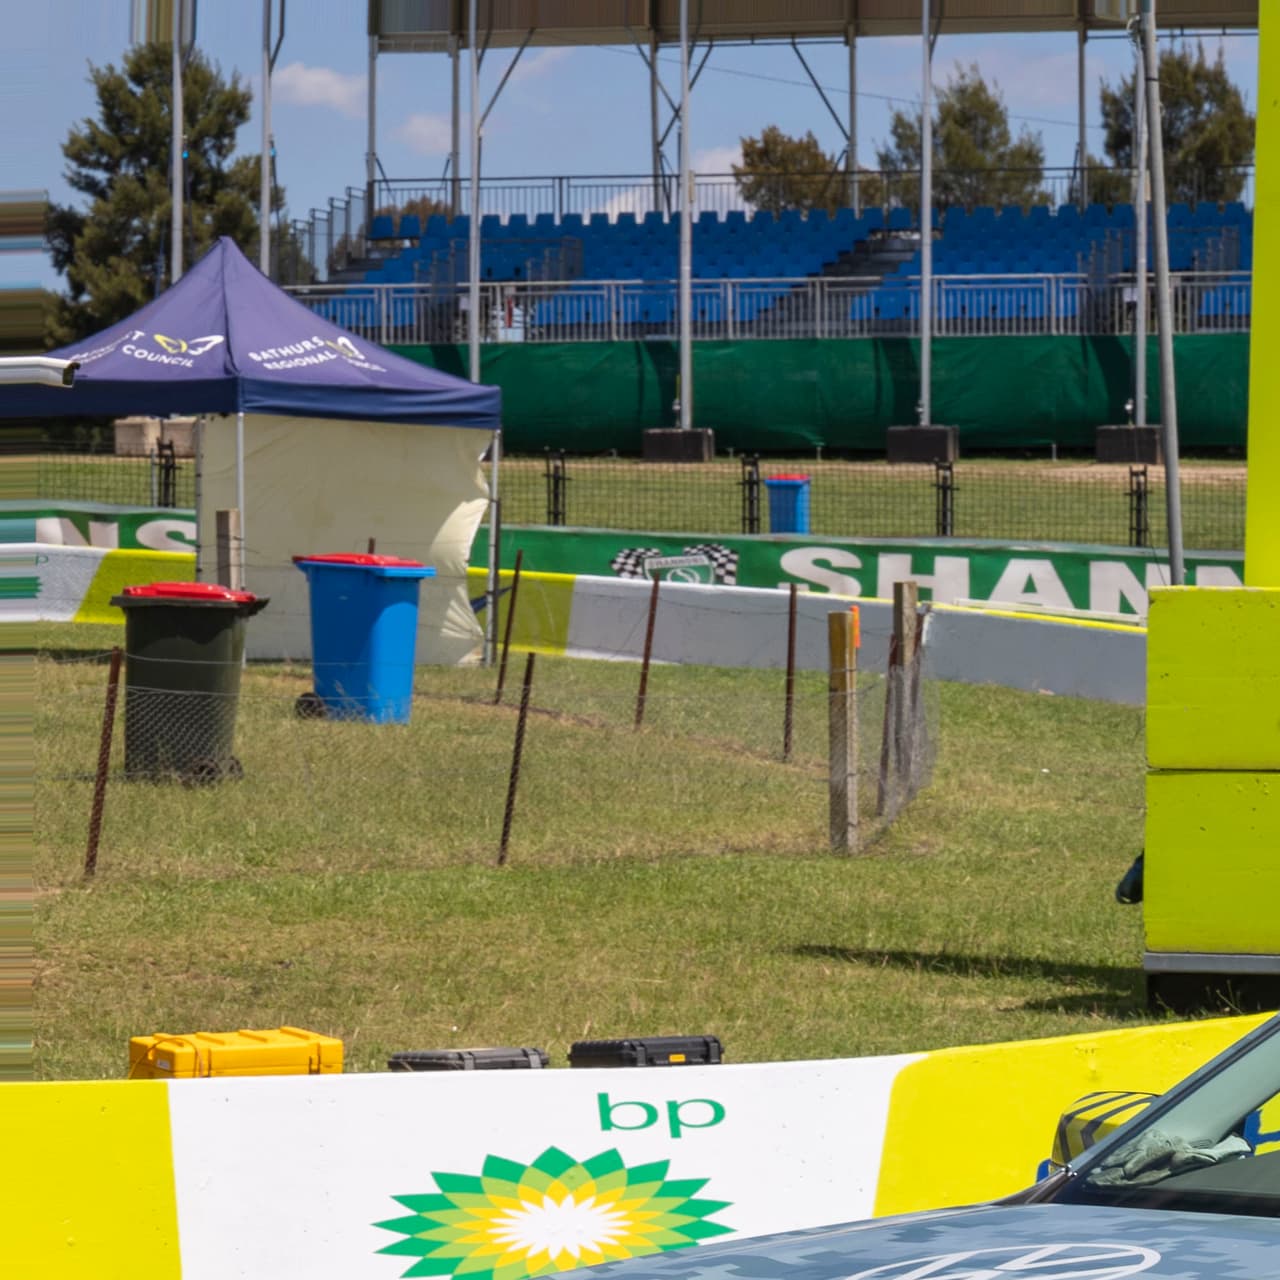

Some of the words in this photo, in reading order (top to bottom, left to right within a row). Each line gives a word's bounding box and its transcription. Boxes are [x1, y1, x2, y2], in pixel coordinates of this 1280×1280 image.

[122, 344, 194, 367] COUNCIL
[264, 350, 338, 370] REGIONAL
[597, 1092, 727, 1138] bp
